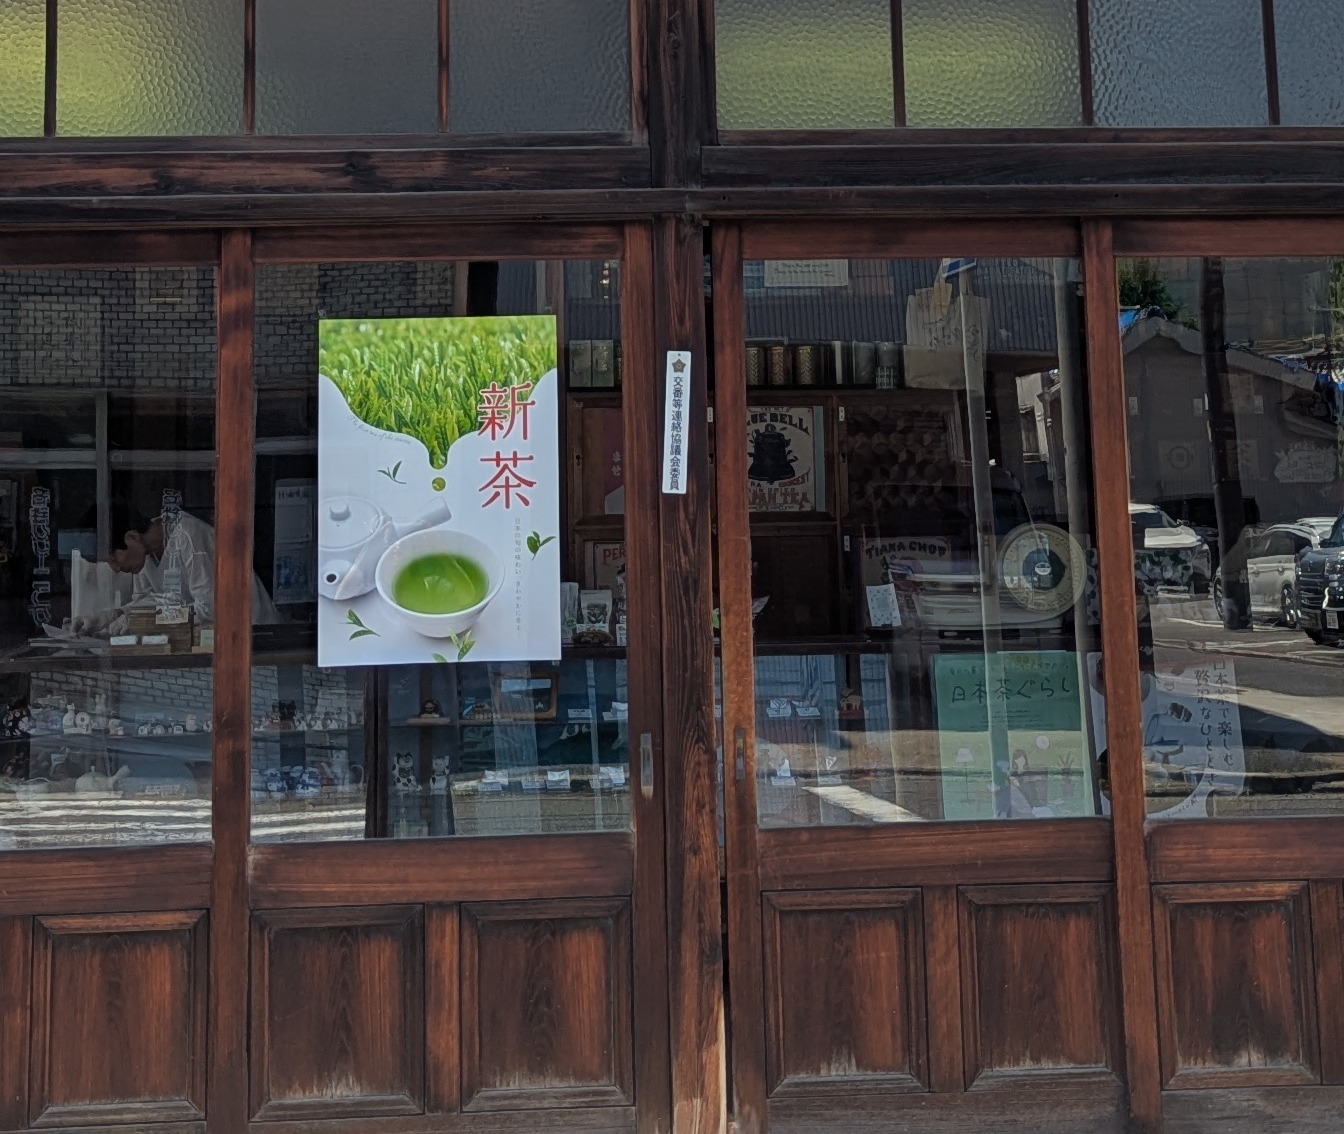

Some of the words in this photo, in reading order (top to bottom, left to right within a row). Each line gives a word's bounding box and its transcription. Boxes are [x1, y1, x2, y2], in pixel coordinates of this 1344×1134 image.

[770, 413, 811, 434] BELL
[477, 381, 537, 510] 新茶
[951, 676, 1071, 704] 日本茶ぐらし
